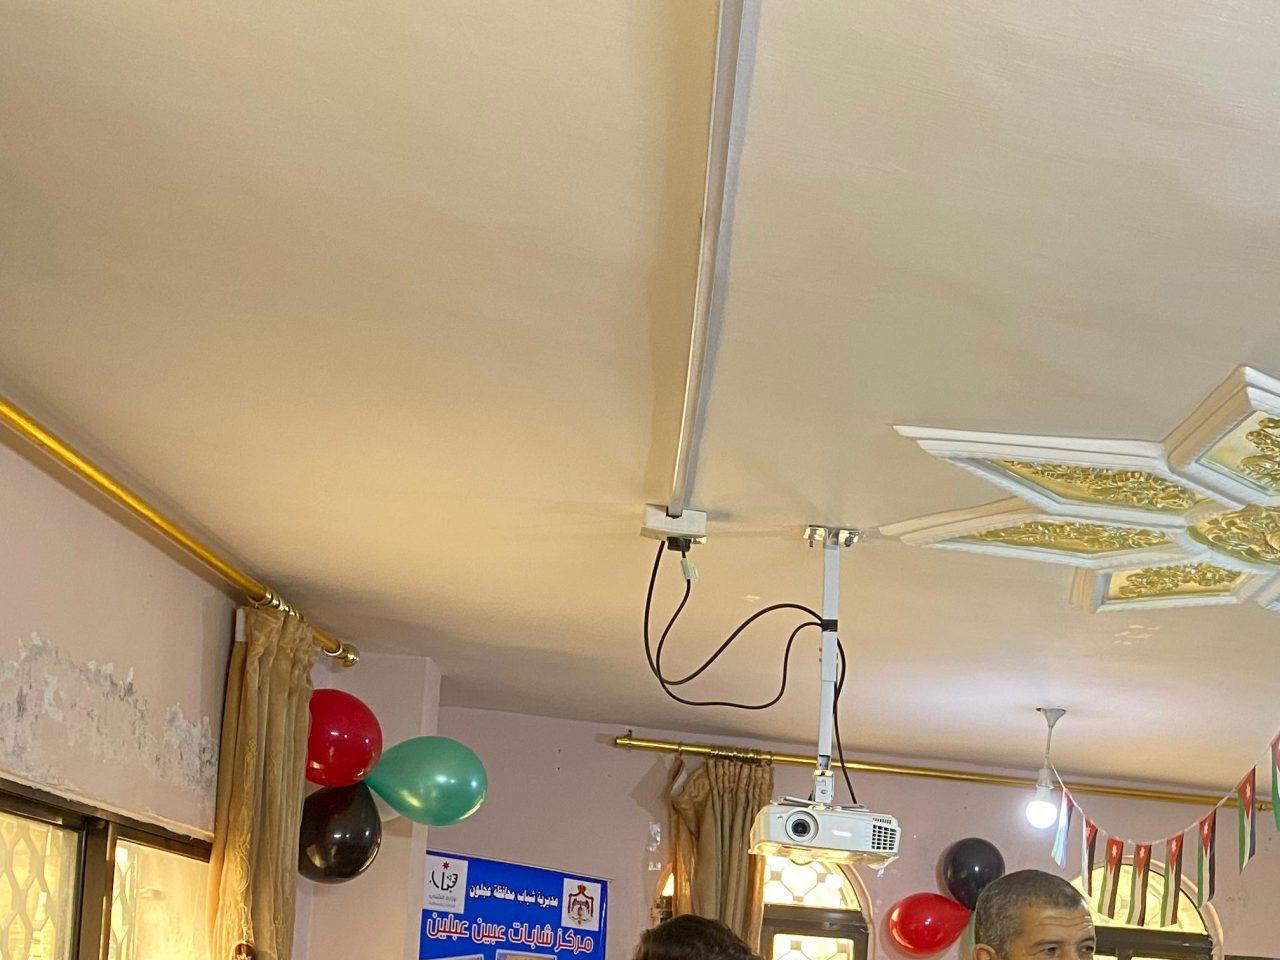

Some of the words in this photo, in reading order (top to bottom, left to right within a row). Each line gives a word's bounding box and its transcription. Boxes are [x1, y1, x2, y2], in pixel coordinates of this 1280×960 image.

[469, 883, 491, 899] عجلون
[493, 884, 515, 901] محافظة
[517, 889, 536, 905] شباب
[537, 891, 559, 908] مديرية
[426, 912, 470, 941] عبلين
[471, 917, 506, 945] عبين
[508, 921, 553, 950] شابات
[554, 927, 594, 955] مركز
